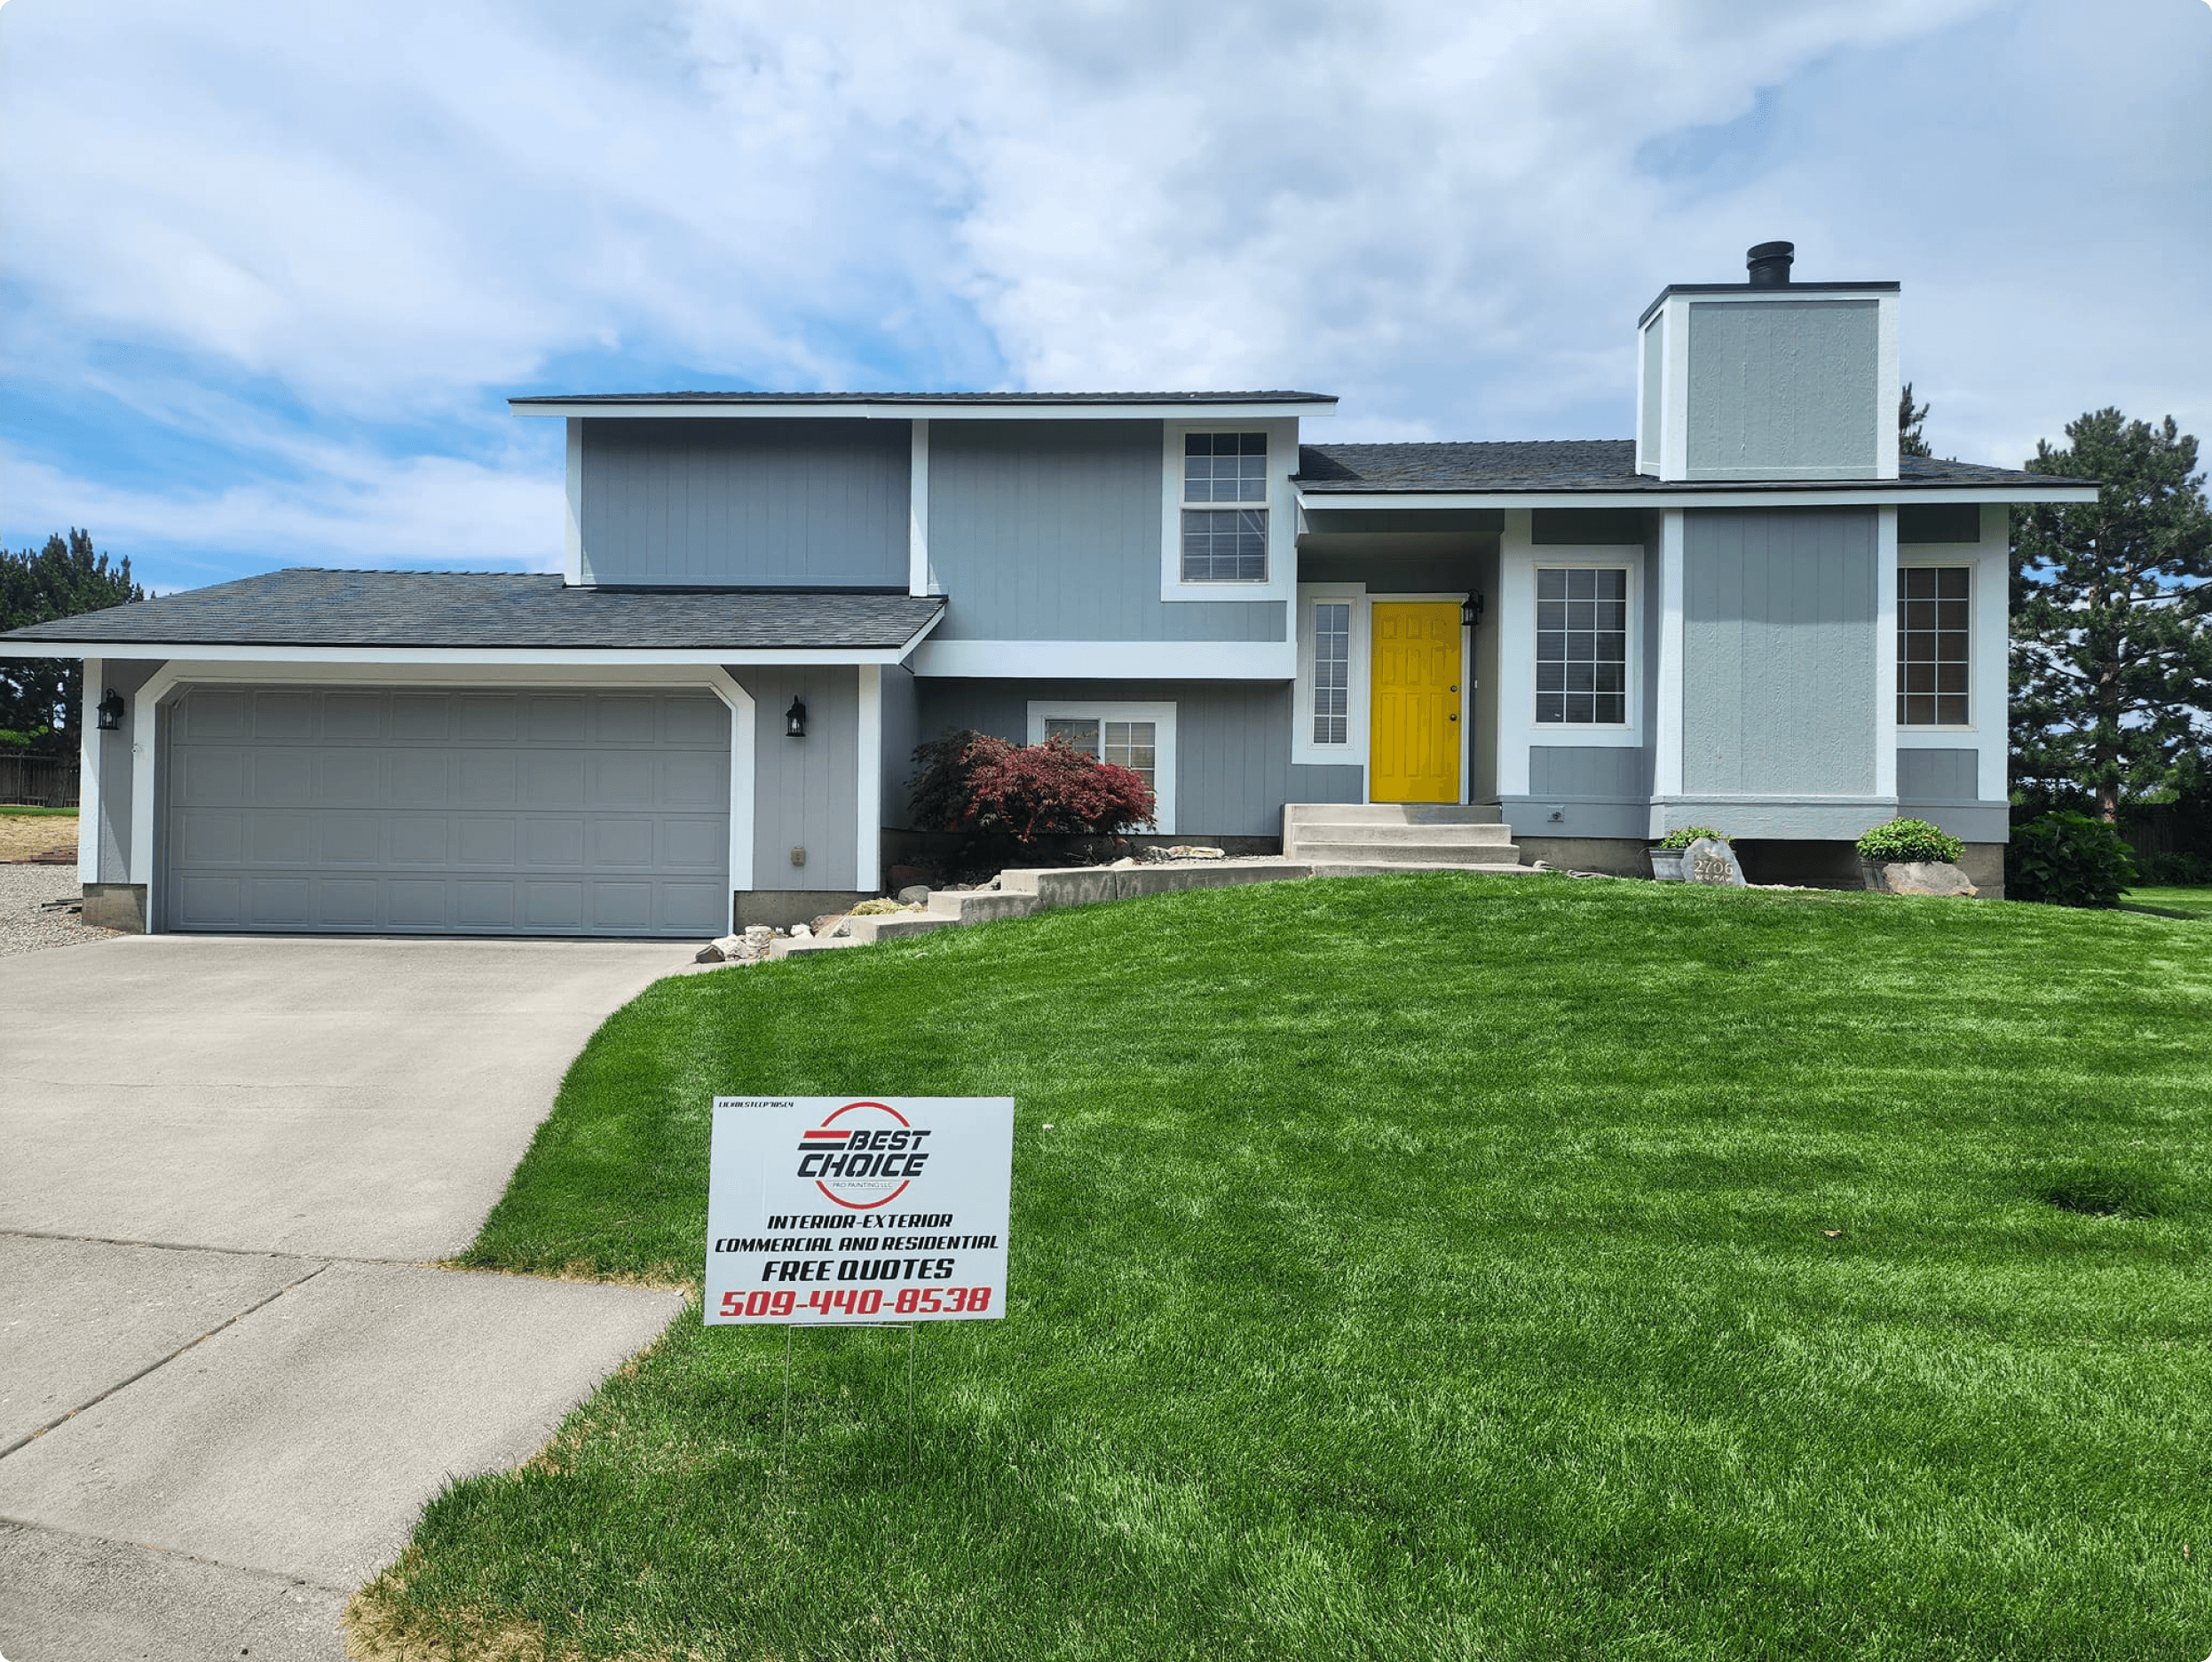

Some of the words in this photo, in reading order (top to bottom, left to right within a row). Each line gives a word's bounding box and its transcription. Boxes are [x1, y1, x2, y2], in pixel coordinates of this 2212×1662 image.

[1694, 859, 1734, 875] 2706
[847, 1130, 932, 1151] BEST
[797, 1153, 929, 1177] CHOICE
[767, 1214, 953, 1230] INTERIOR-EXTERIOR
[715, 1237, 834, 1253] COMMERCIAL
[838, 1236, 879, 1252] AND
[881, 1235, 999, 1251] RESIDENTIAL
[762, 1260, 835, 1282] FREE
[837, 1258, 955, 1281] QUOTES
[719, 1286, 992, 1317] 509-440-8538
